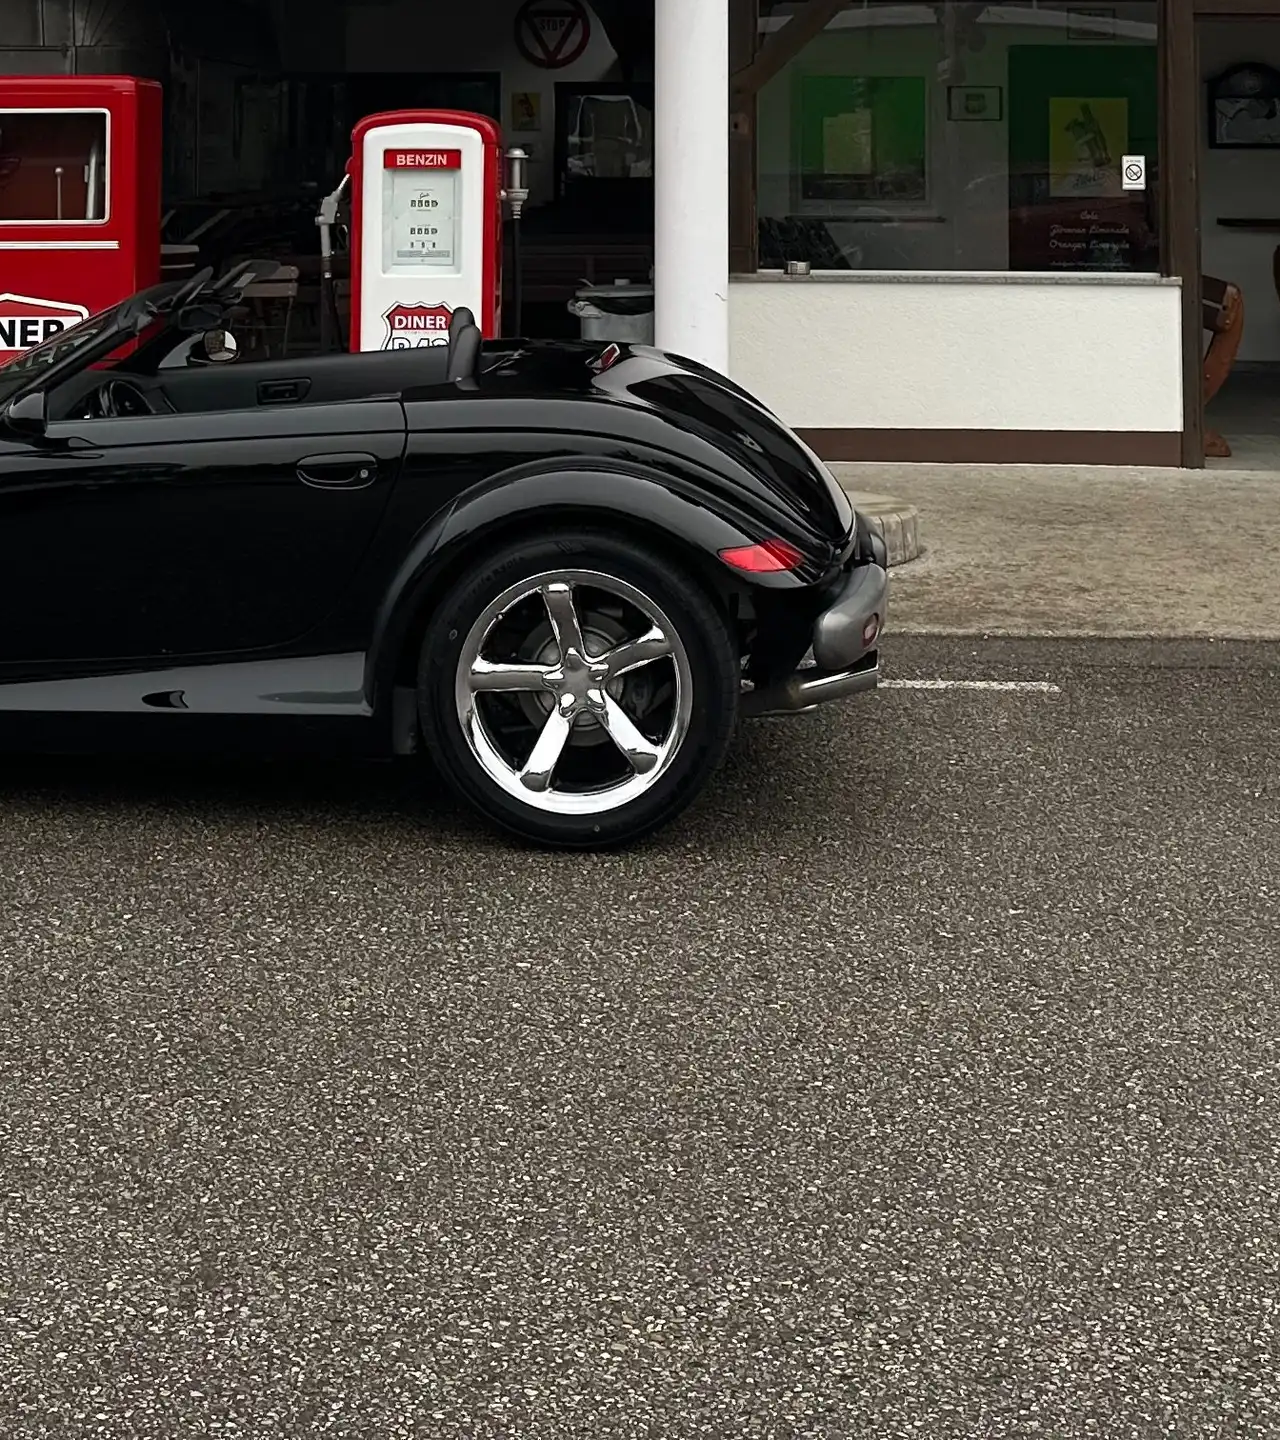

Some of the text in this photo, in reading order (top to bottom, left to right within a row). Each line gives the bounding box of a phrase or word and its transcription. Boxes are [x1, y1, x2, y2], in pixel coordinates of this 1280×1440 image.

[538, 18, 566, 32] STOP
[396, 153, 447, 166] BENZIN
[394, 315, 447, 329] DINER
